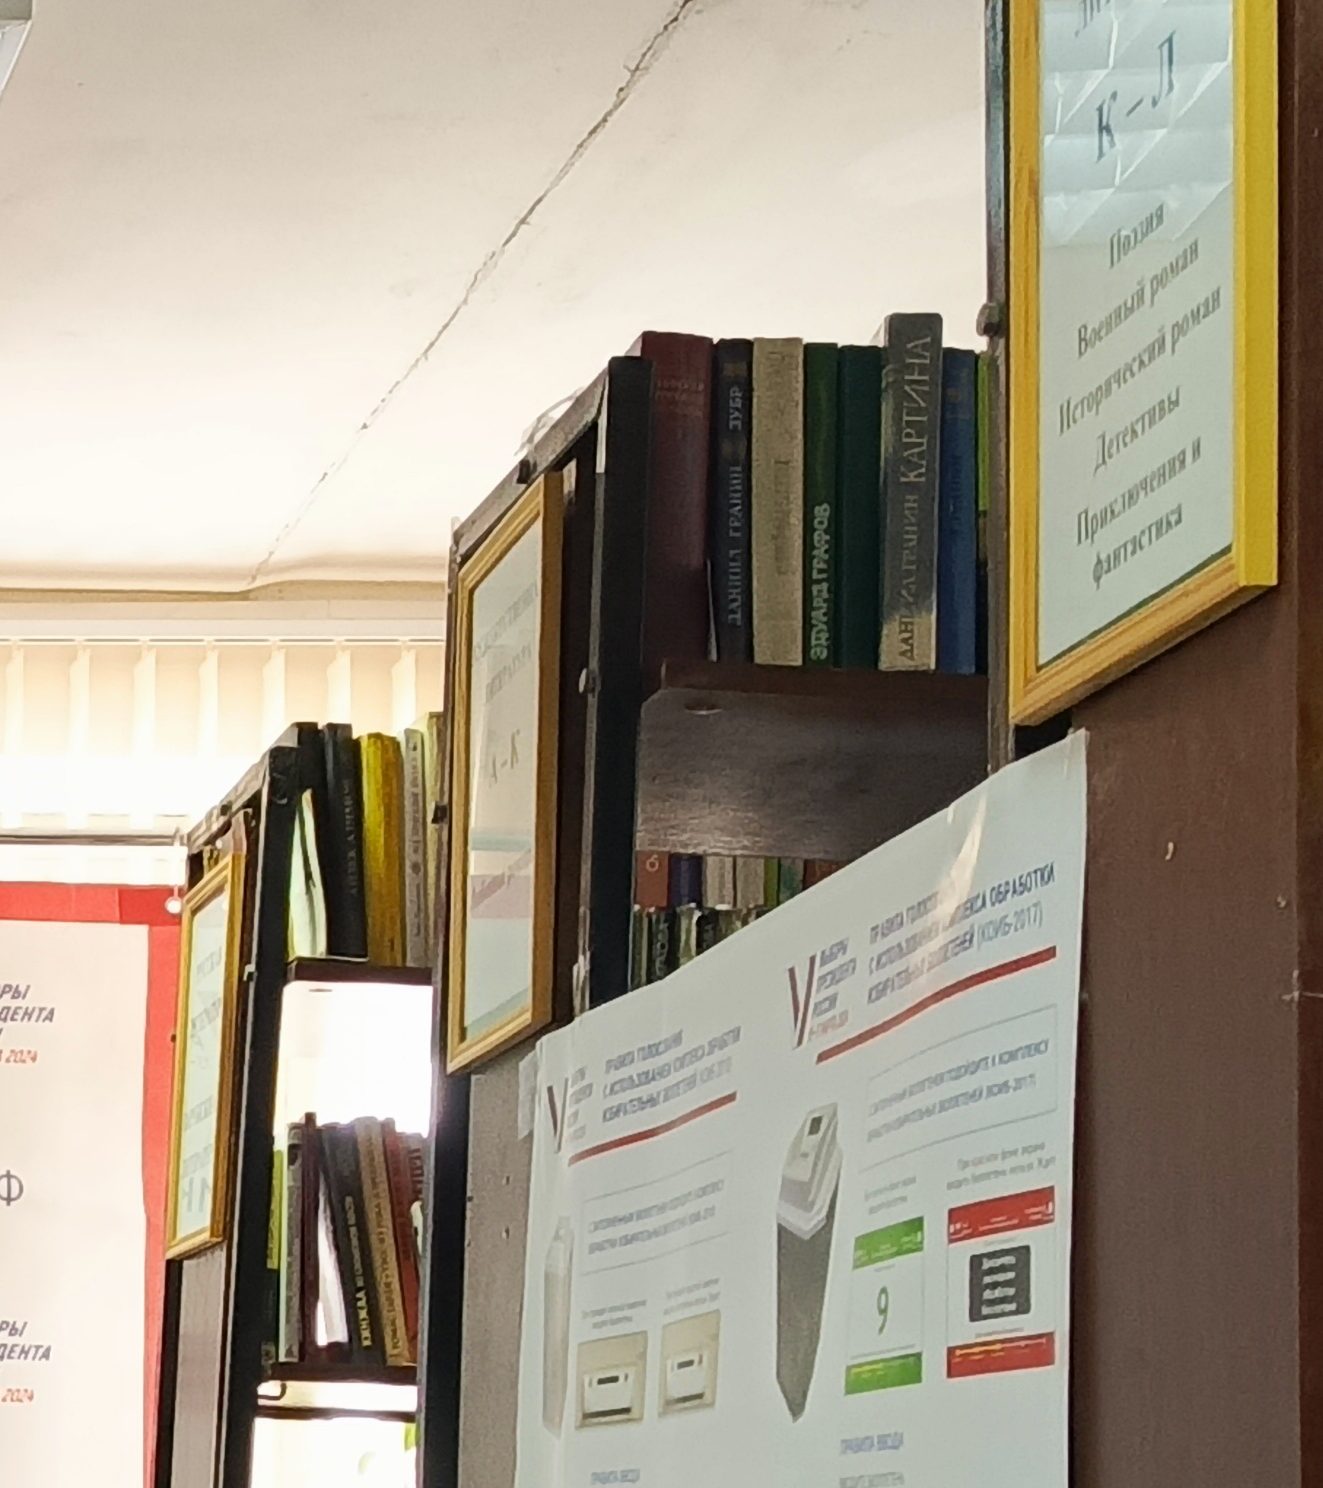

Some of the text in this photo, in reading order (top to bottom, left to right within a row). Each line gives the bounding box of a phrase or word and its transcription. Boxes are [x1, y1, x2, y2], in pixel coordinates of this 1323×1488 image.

[1109, 202, 1164, 269] Поэзия
[1078, 238, 1199, 359] Военный роман
[1059, 286, 1221, 436] Исторический роман
[900, 336, 932, 483] КАРТИНА
[1094, 386, 1180, 477] Детективы
[811, 503, 830, 580] ГРАФОВ
[1076, 447, 1187, 548] Приключения
[1092, 503, 1183, 590] фантастика
[5, 1049, 37, 1063] 2024
[2, 1389, 34, 1403] 2024
